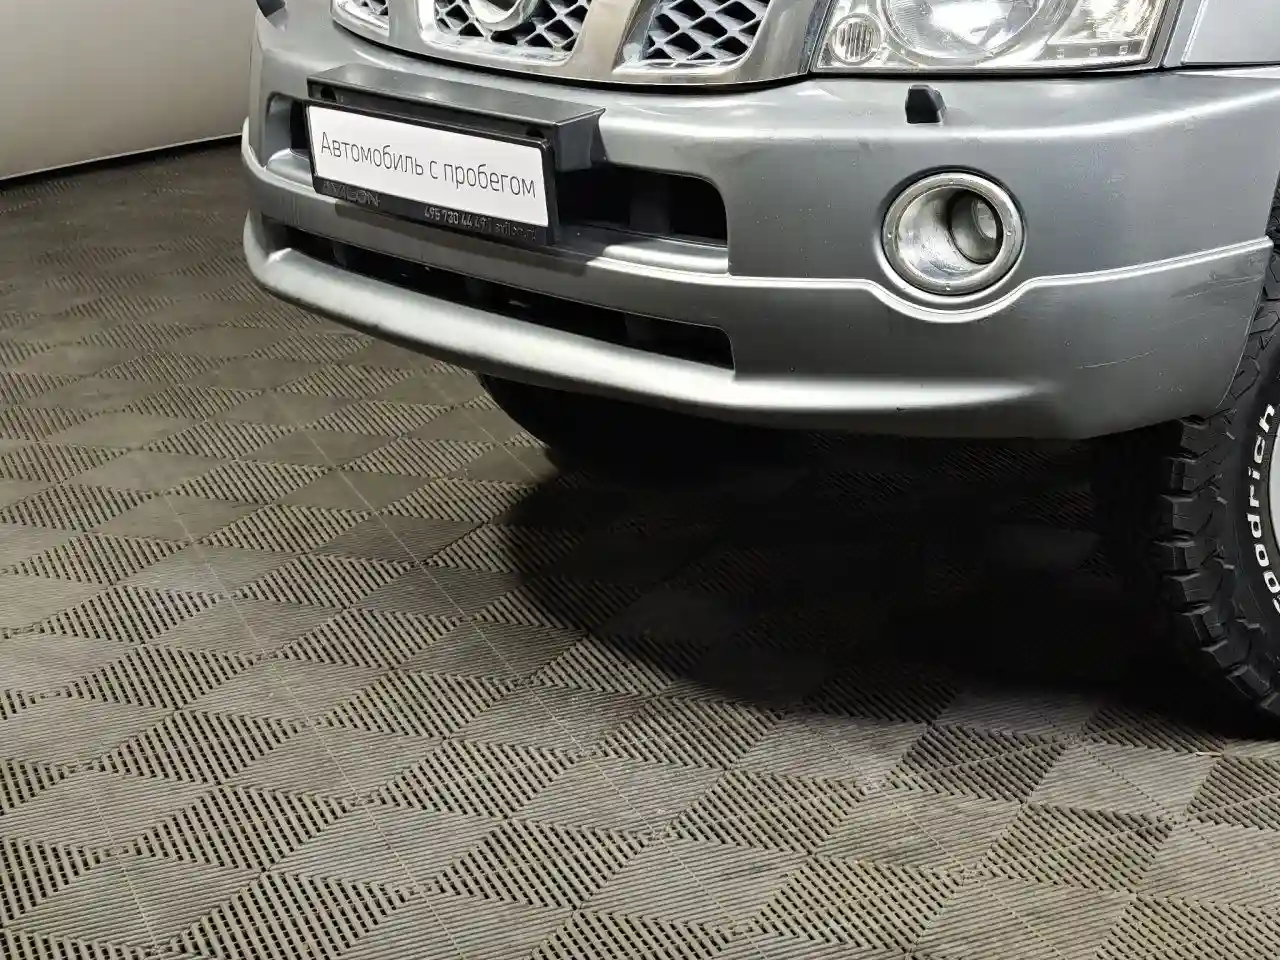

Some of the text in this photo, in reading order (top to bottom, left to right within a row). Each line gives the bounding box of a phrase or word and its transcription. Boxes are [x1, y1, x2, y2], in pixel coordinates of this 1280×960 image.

[320, 131, 536, 199] Автомобиль с пробегом
